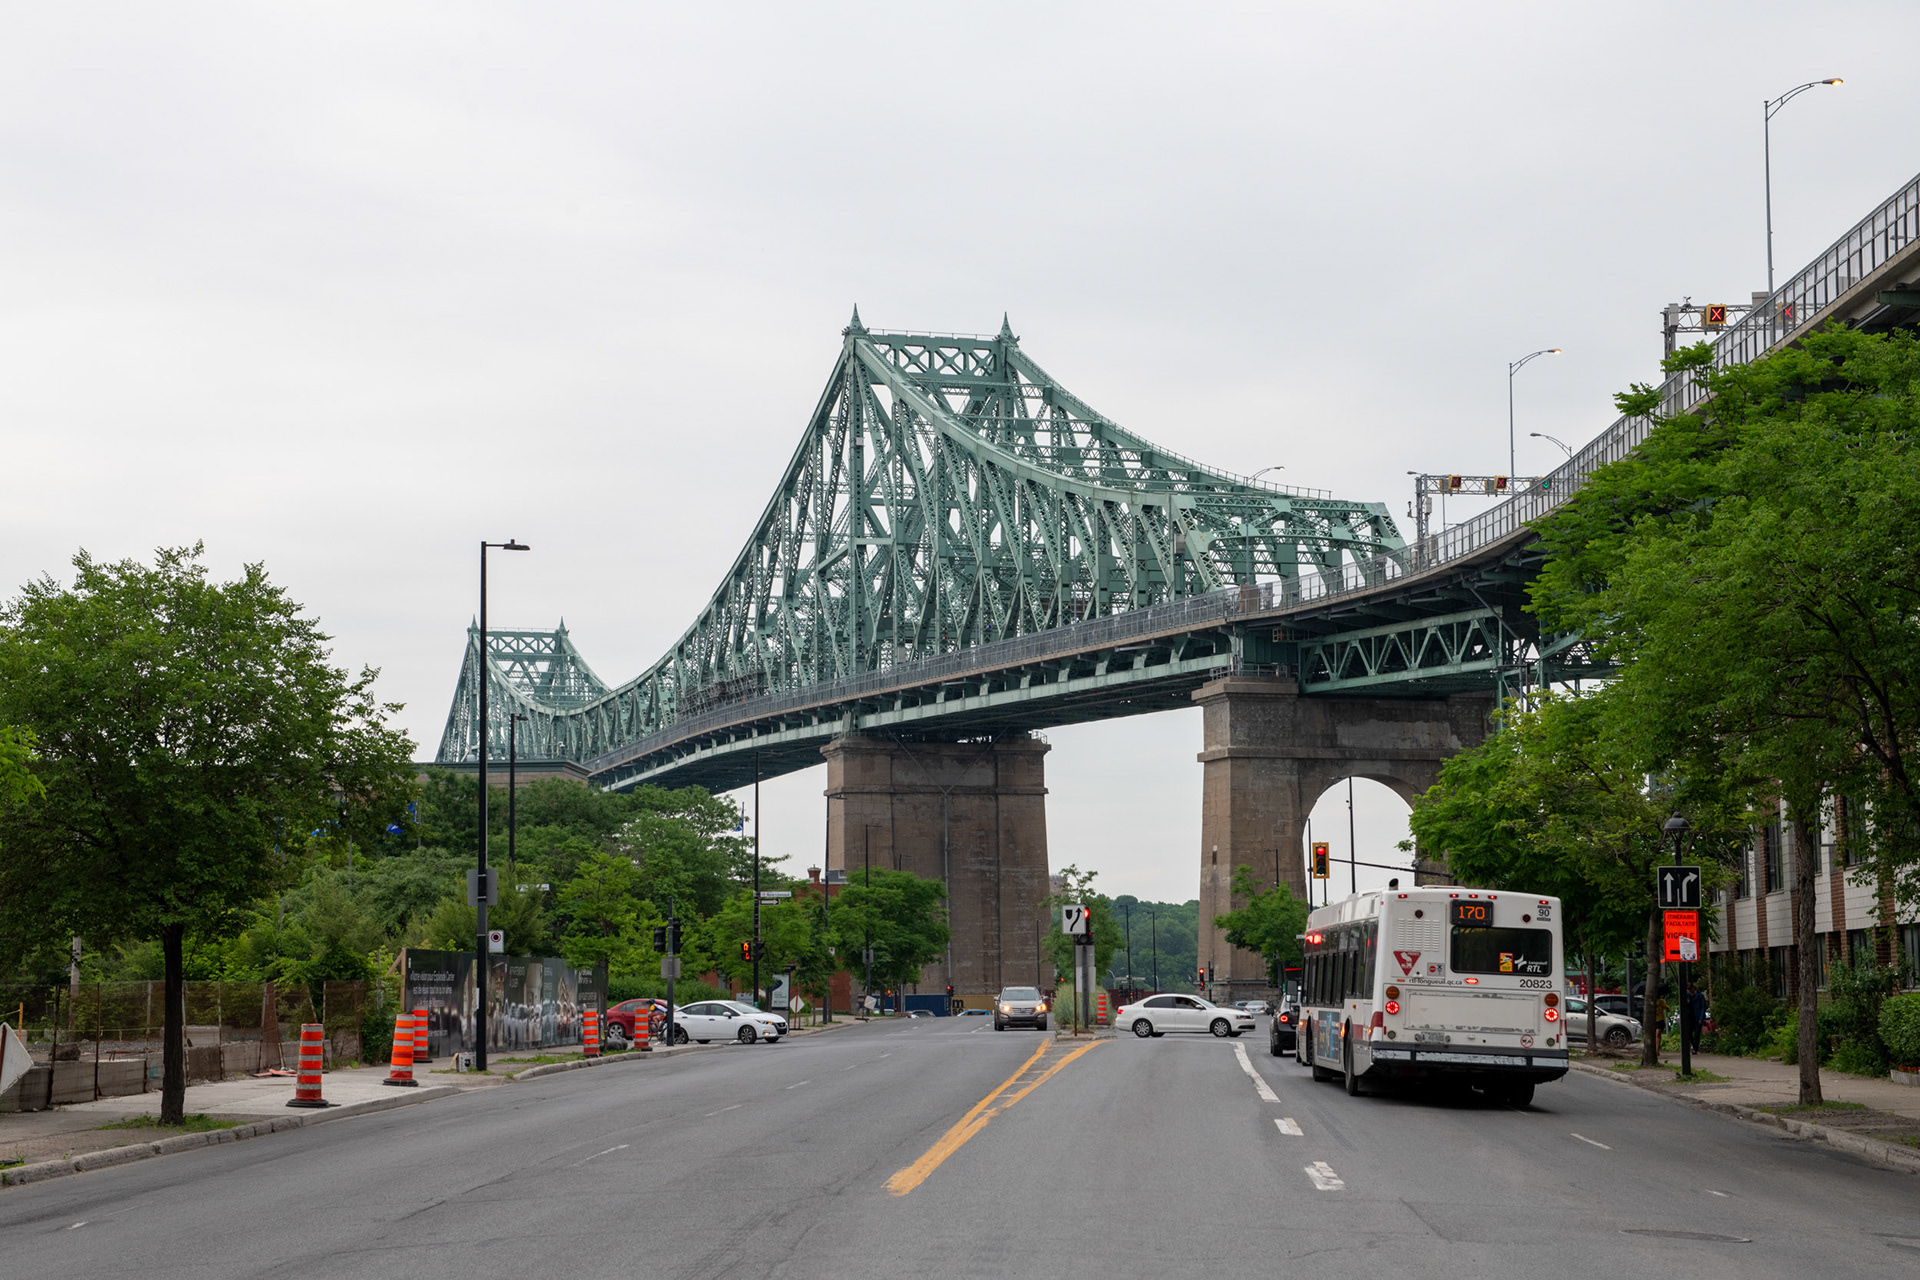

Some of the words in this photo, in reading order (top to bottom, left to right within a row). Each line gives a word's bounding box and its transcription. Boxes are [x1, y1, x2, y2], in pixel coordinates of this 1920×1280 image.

[1459, 906, 1485, 920] 170
[1538, 908, 1550, 917] 90
[1527, 965, 1542, 973] RTL
[1519, 979, 1552, 989] 20823
